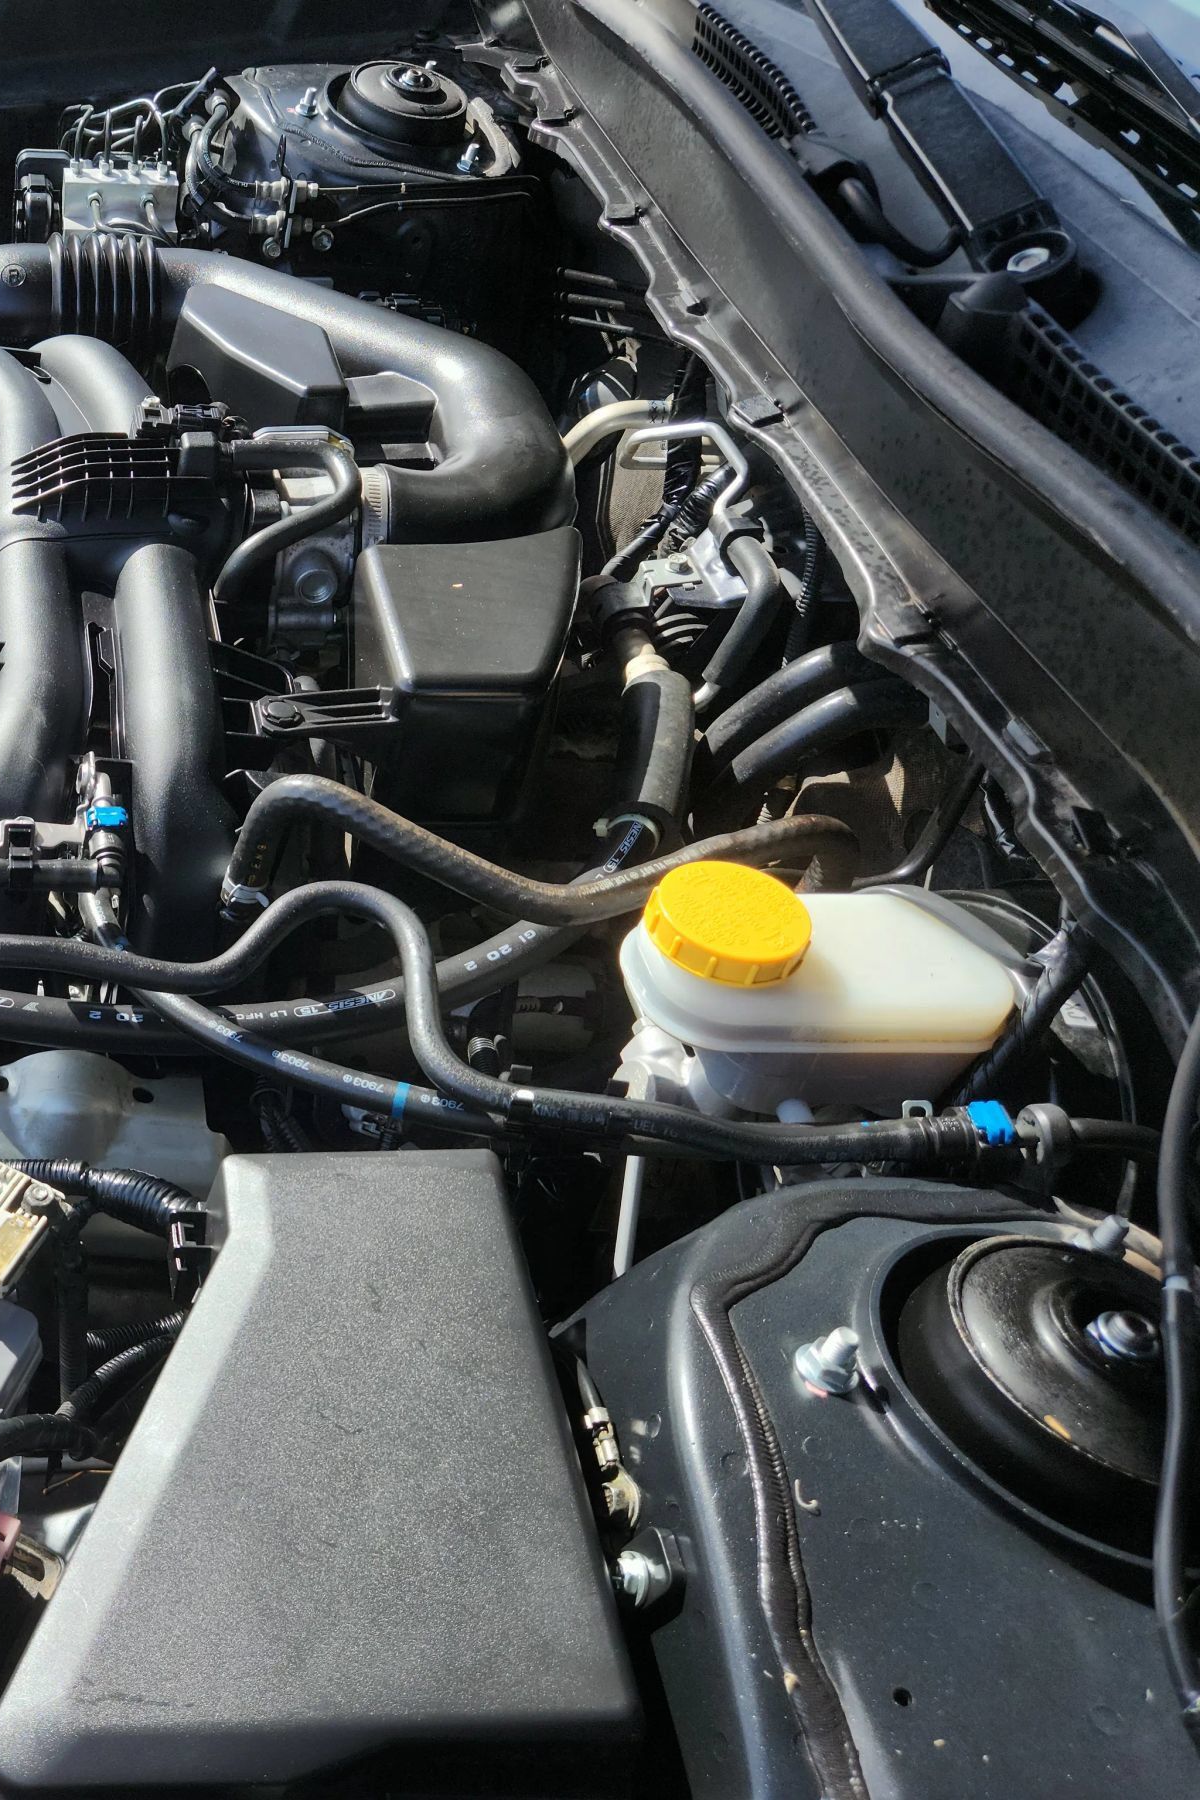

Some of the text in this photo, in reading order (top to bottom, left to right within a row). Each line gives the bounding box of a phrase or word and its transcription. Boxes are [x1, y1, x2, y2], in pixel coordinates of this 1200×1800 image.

[618, 821, 642, 854] NESIS
[484, 940, 513, 965] 20
[462, 957, 479, 973] 2
[88, 1009, 101, 1019] 2
[269, 1008, 287, 1018] LP
[298, 1004, 318, 1017] 15
